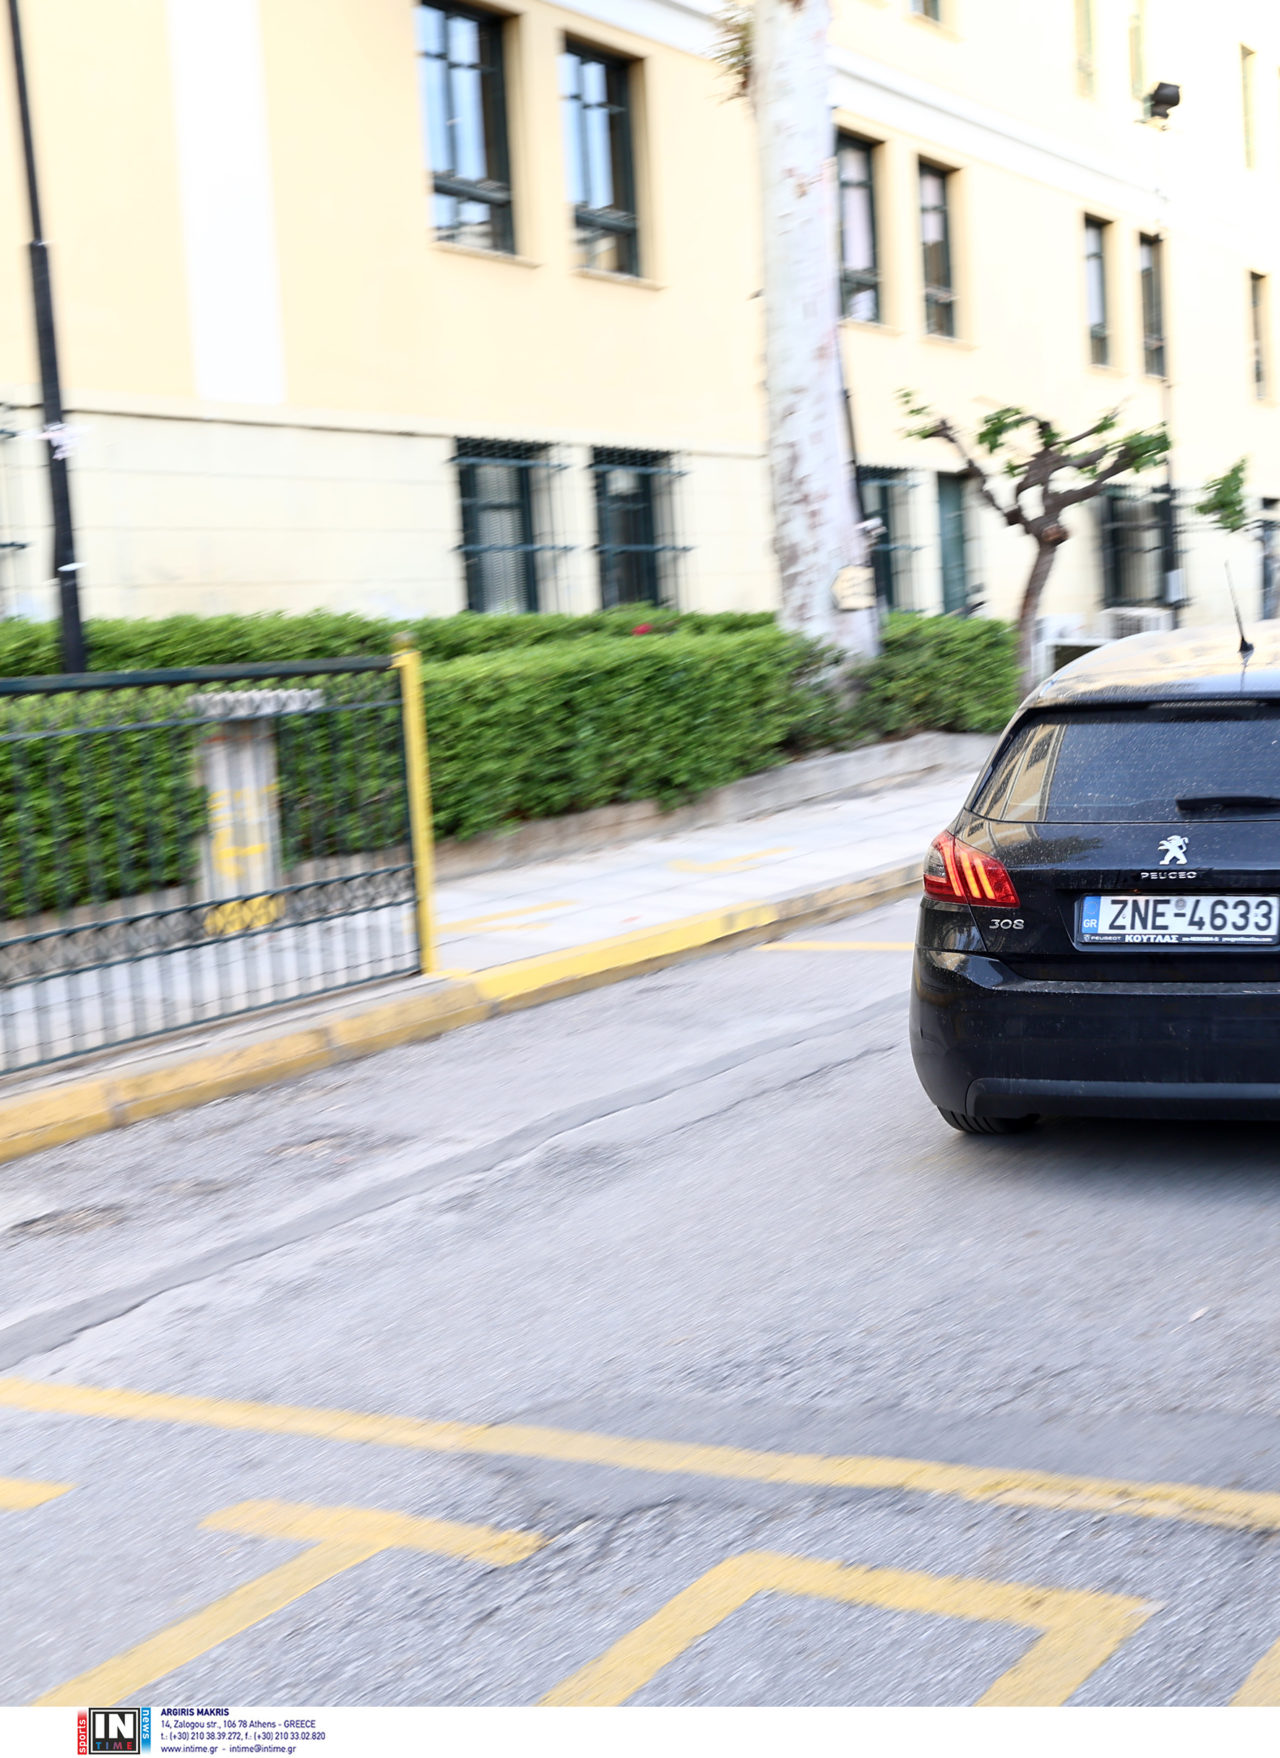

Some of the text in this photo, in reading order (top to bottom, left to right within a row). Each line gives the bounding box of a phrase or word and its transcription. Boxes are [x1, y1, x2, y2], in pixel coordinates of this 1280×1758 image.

[1108, 899, 1272, 931] ZNE-4633
[989, 918, 1025, 930] 308
[1083, 918, 1097, 928] GR
[1125, 934, 1179, 943] ΚΟΥΤΛΑΣ
